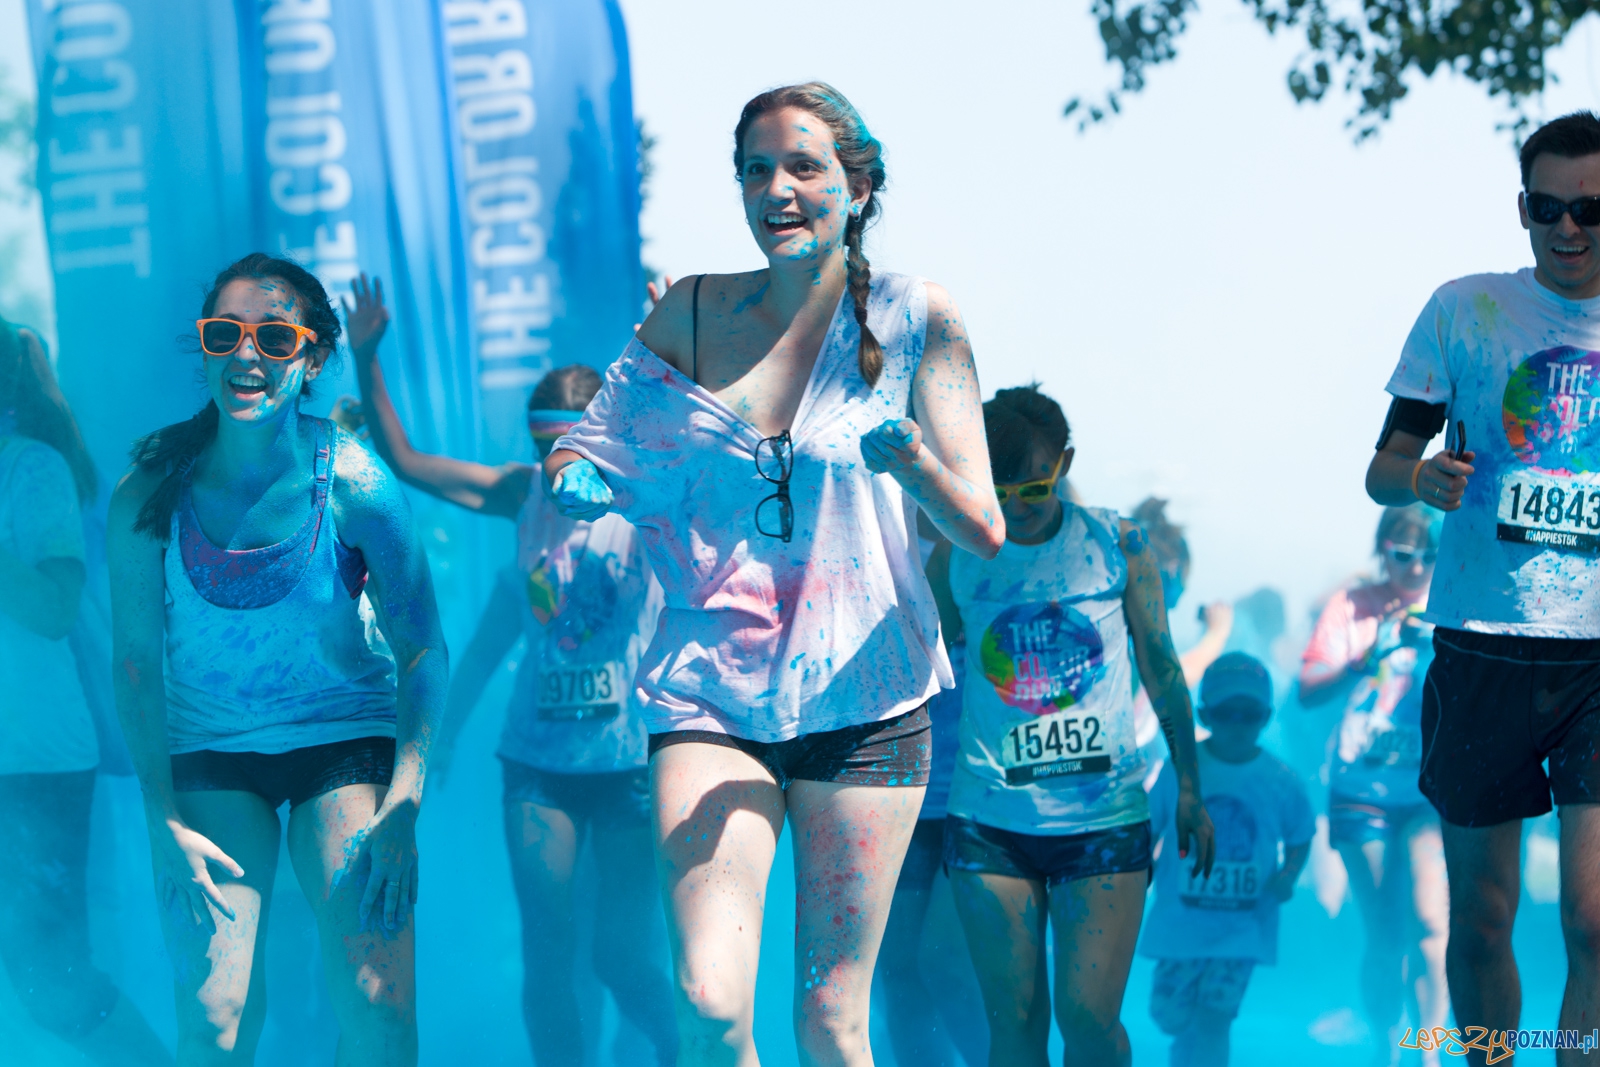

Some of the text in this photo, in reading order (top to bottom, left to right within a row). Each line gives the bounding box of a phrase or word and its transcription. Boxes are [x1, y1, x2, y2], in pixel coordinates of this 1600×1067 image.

[1546, 361, 1592, 395] THE
[1510, 482, 1600, 531] 14843
[1008, 619, 1060, 653] THE
[1012, 645, 1091, 683] COLOR
[540, 668, 612, 703] 9703
[1009, 716, 1103, 763] 15452
